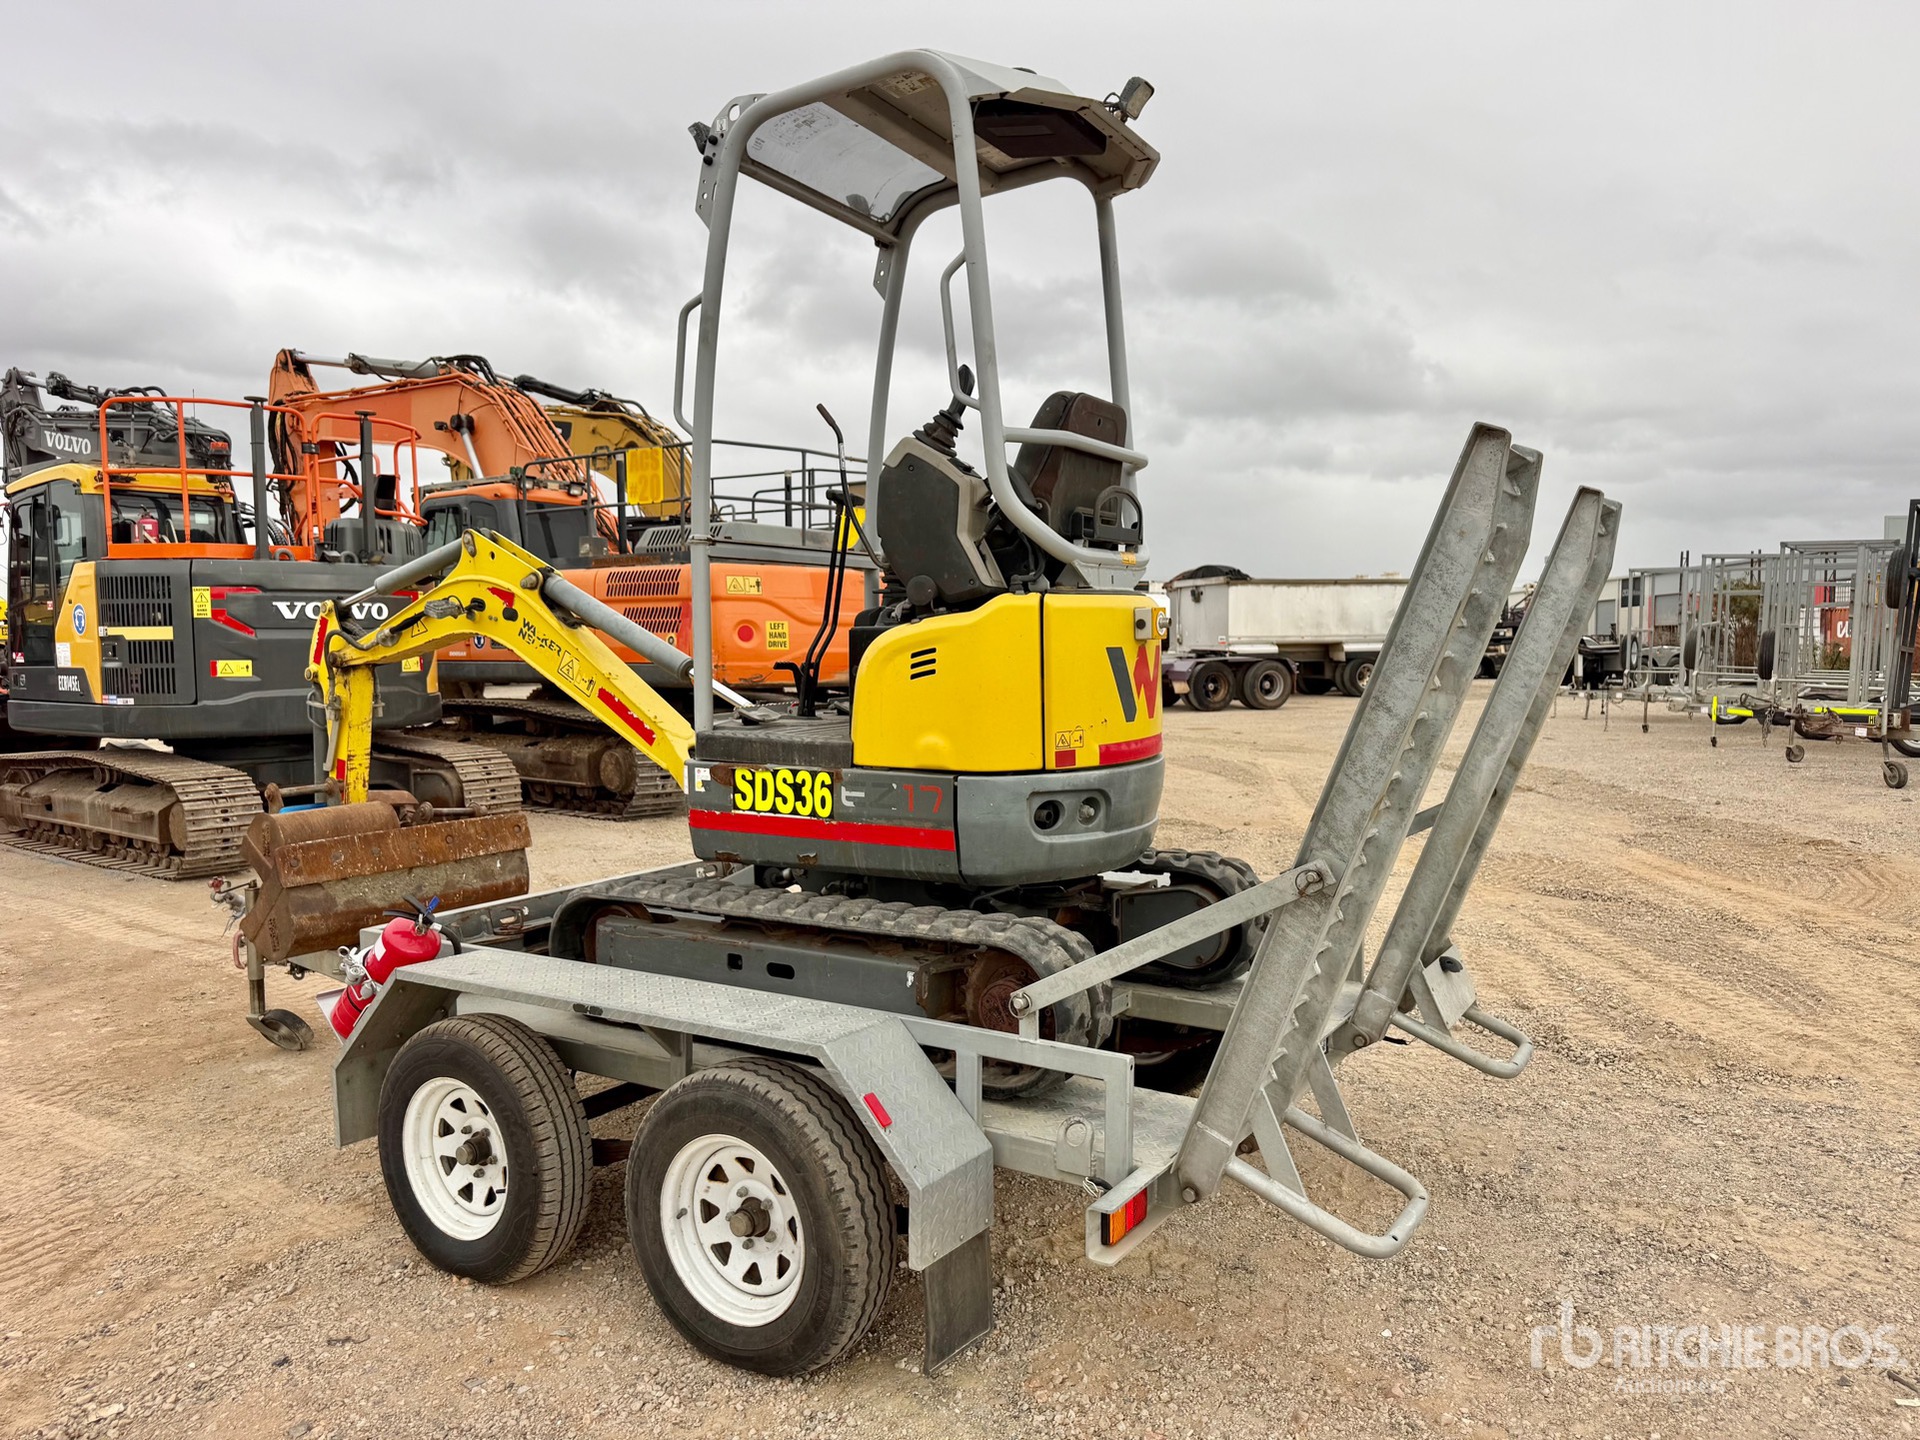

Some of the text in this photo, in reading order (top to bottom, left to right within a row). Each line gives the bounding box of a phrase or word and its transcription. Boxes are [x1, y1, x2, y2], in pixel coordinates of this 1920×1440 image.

[44, 430, 91, 455] VOLVO
[272, 601, 389, 620] VOVO
[769, 622, 784, 630] LEFT
[769, 631, 787, 639] HAND
[768, 640, 787, 648] DRIVE
[734, 767, 833, 819] SDS36
